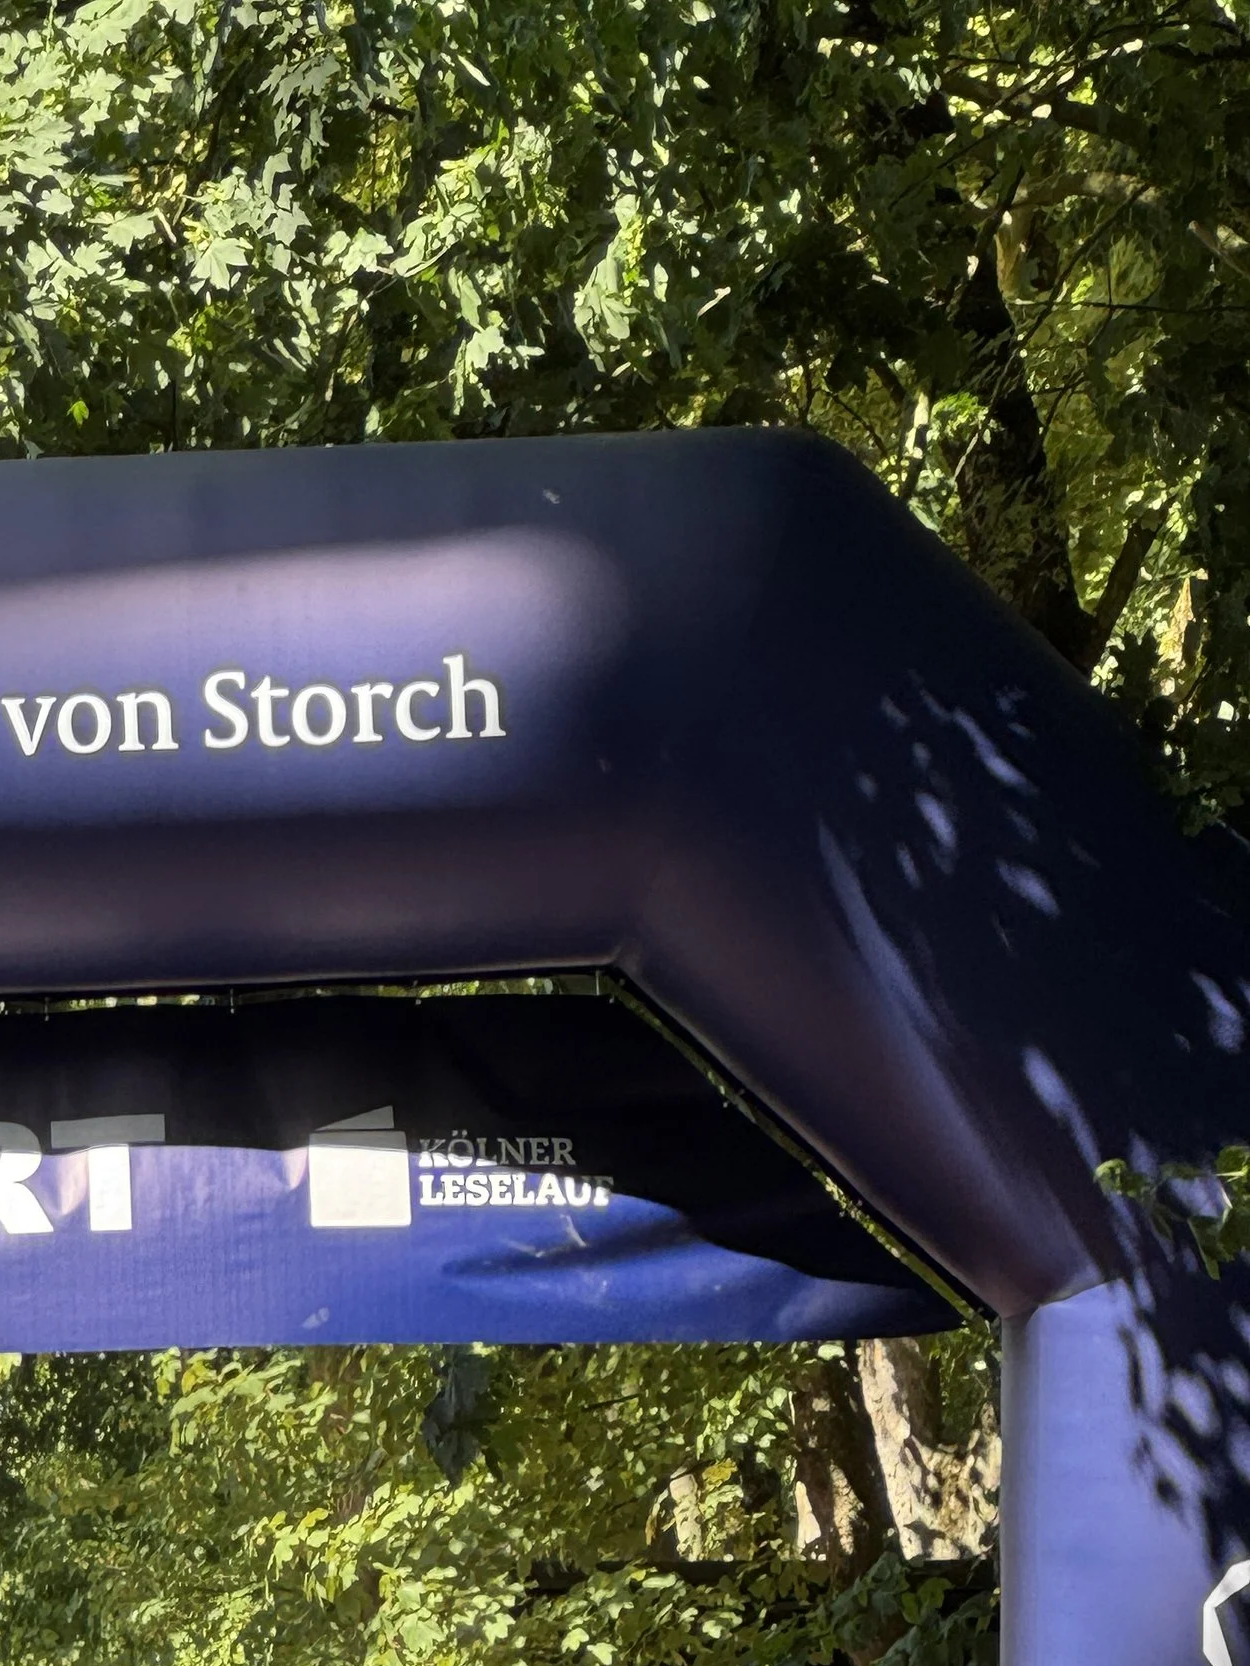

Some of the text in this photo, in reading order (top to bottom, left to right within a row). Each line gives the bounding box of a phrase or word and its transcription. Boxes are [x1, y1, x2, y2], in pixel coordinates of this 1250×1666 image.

[0, 687, 179, 757] von
[202, 653, 506, 749] Storch
[418, 1129, 577, 1168] KÖLNER
[418, 1172, 615, 1207] LESELAUF
